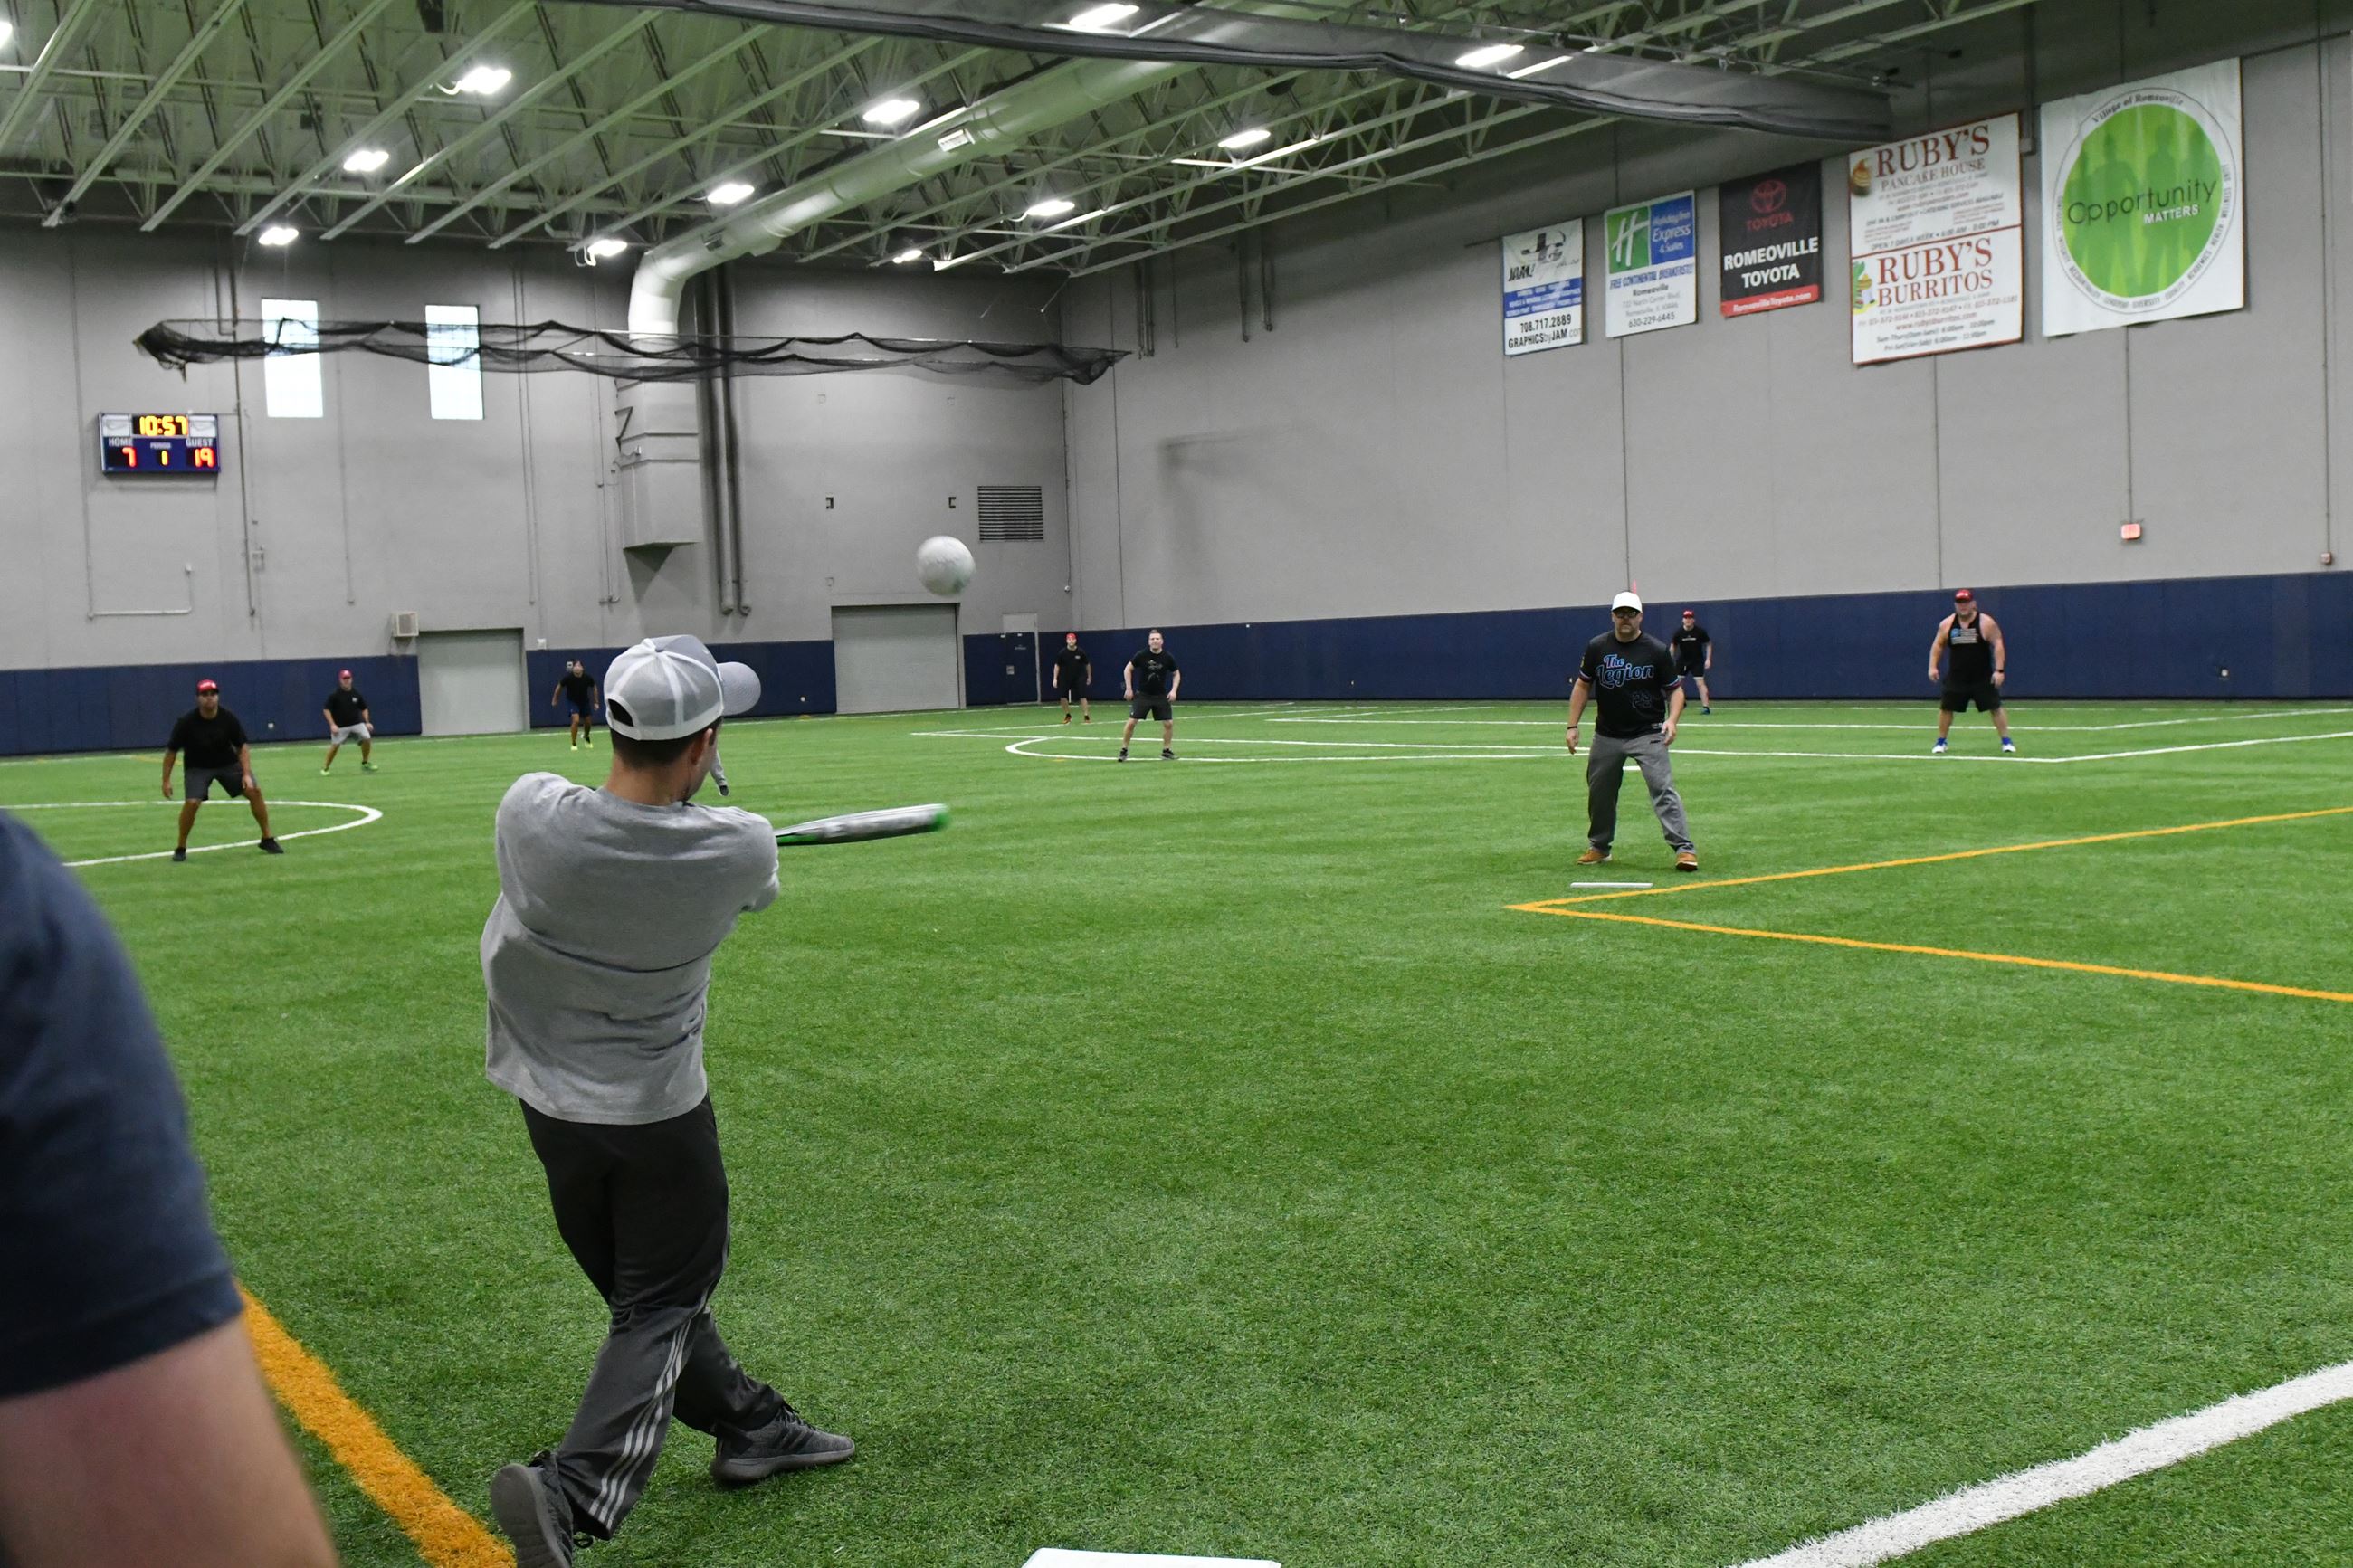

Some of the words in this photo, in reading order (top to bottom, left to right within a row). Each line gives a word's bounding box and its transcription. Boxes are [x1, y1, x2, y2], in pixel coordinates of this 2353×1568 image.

[1875, 124, 1990, 177] RUBY'S
[1881, 168, 1939, 191] PANCAKE
[1940, 157, 1985, 178] HOUSE
[2067, 178, 2218, 227] Opportunity
[1747, 212, 1794, 232] TOYOTA
[2143, 204, 2200, 224] MATTERS
[1652, 224, 1691, 242] Express
[1724, 236, 1819, 271] ROMEOVILLE
[1877, 237, 1993, 285] RUBY'S
[1741, 263, 1800, 289] TOYOTA
[1633, 283, 1669, 297] Romeoville
[1877, 270, 1993, 308] BURRITOS
[1520, 313, 1572, 333] 708.717.2889
[139, 415, 188, 436] 10:57
[109, 437, 133, 447] HOME
[186, 438, 214, 448] GUEST
[122, 447, 137, 467] 7
[161, 450, 169, 466] 1
[195, 447, 214, 467] 19
[1603, 653, 1624, 669] The
[1596, 663, 1655, 689] Legion
